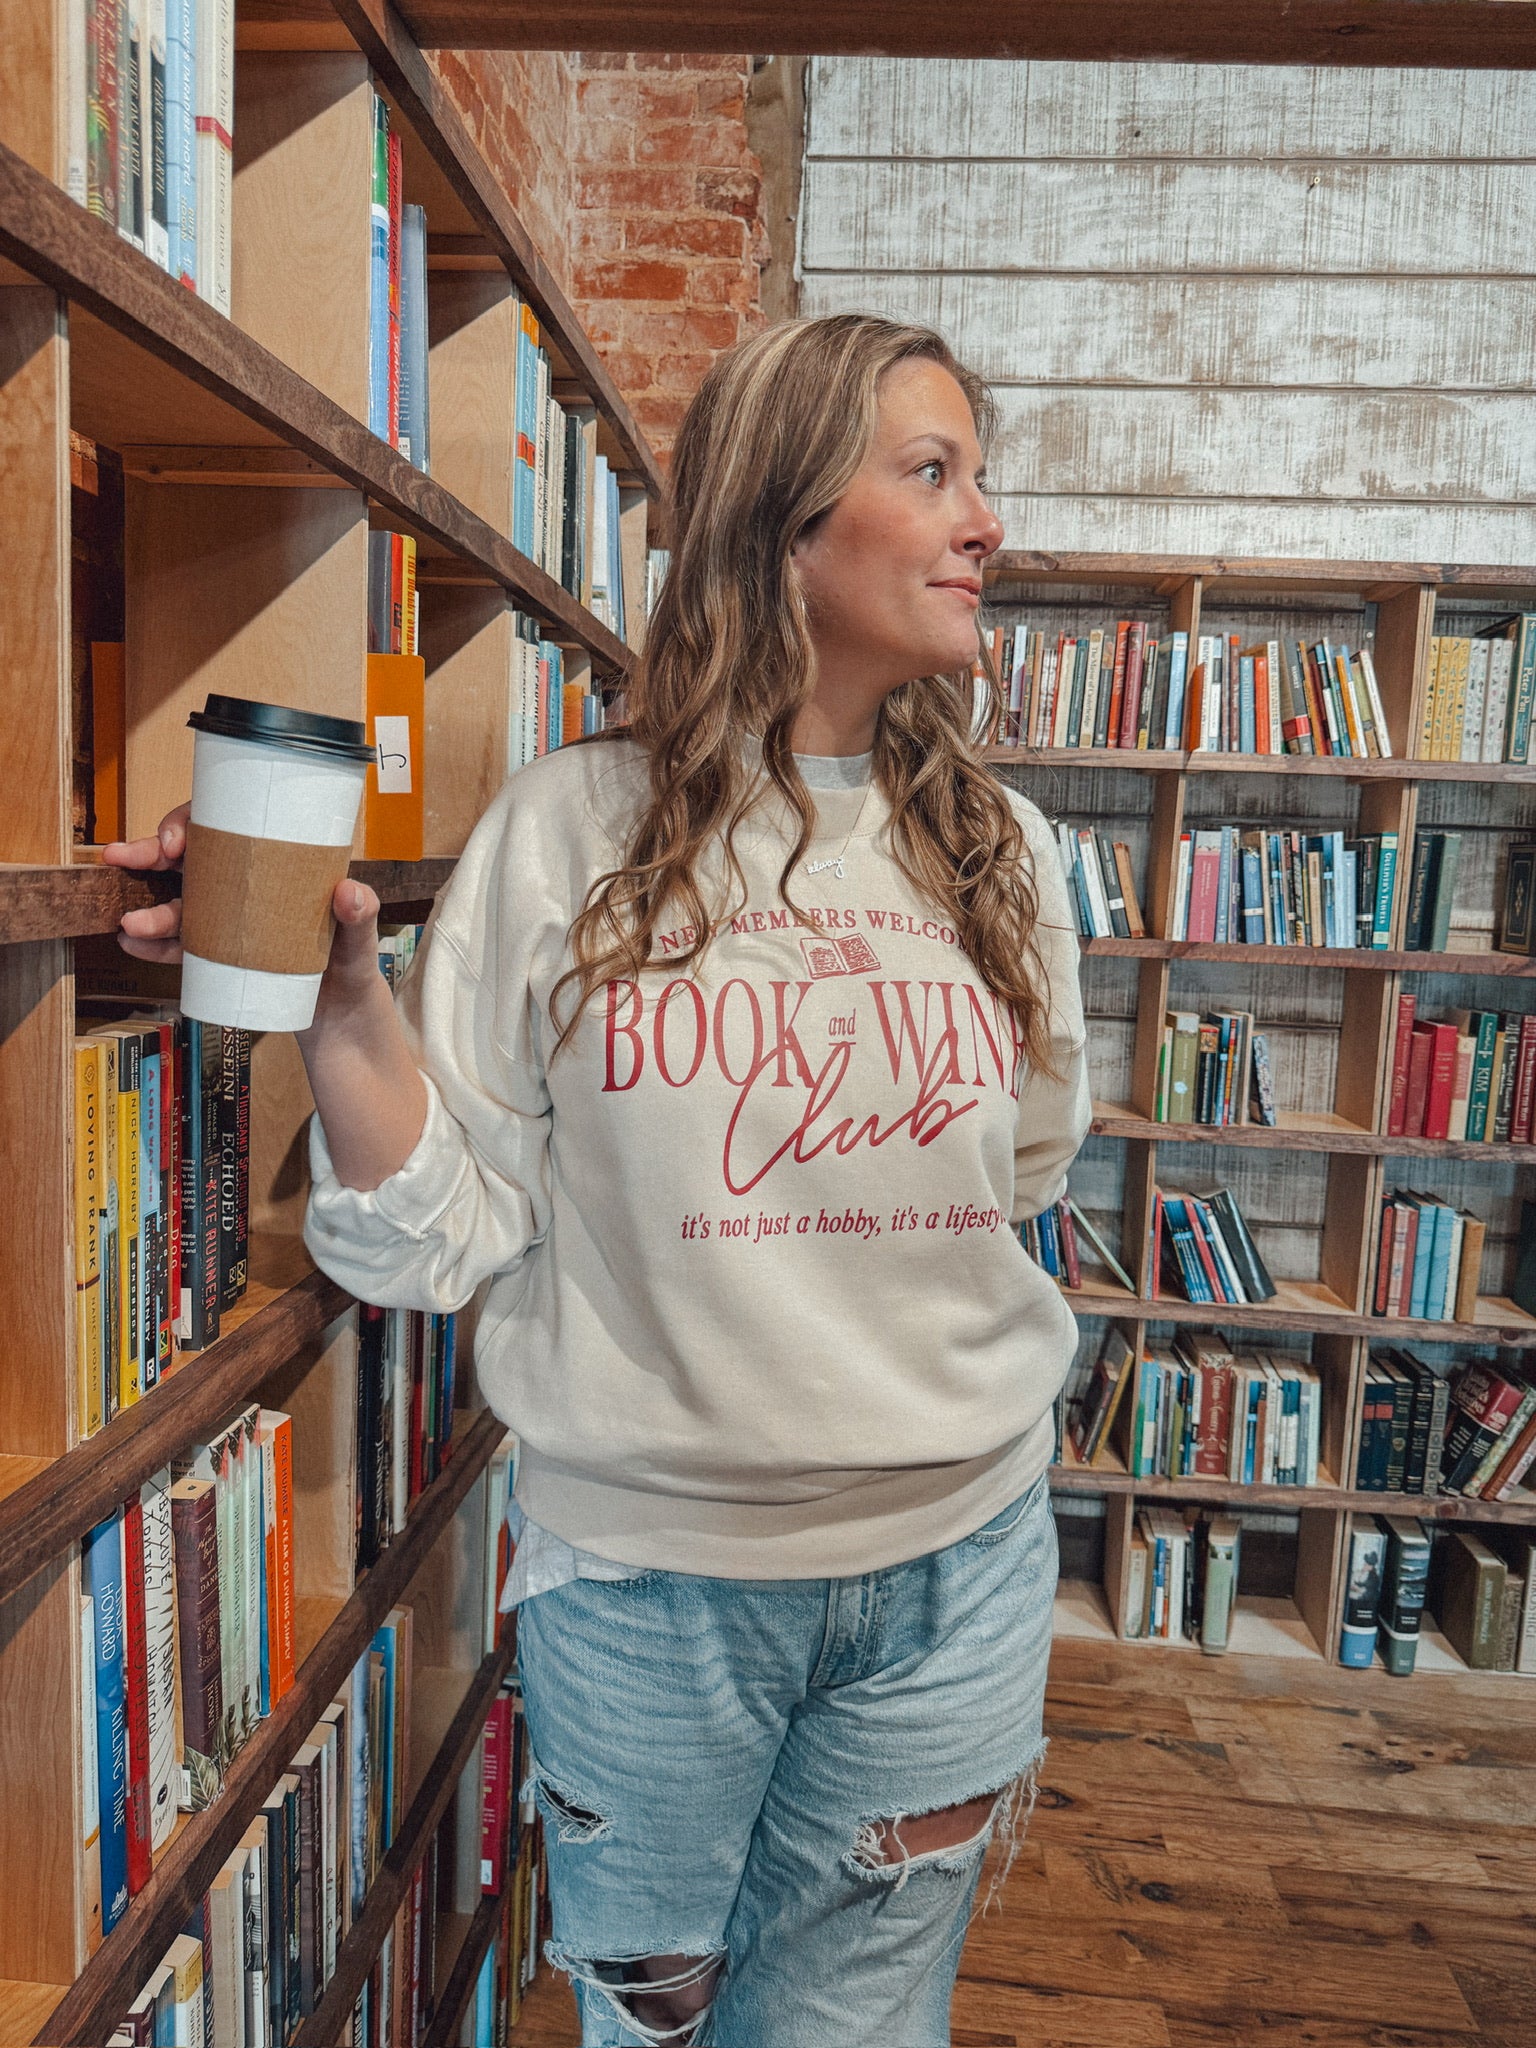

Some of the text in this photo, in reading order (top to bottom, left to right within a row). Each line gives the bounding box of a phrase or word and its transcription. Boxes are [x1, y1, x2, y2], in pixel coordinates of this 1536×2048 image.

[220, 36, 230, 80] book
[130, 57, 141, 177] HERE ON EARTH
[182, 65, 192, 133] PARADISE
[153, 76, 165, 196] HERE ON EARTH
[182, 139, 192, 186] HOTEL
[180, 196, 188, 242] HOGAN
[187, 208, 196, 242] RUTH
[1518, 667, 1533, 714] Peter Pan
[600, 978, 816, 1093] BOOK
[828, 1008, 856, 1037] and
[1475, 1067, 1490, 1092] KIM
[239, 1094, 249, 1152] THOUSAND
[722, 1026, 979, 1197] Club
[205, 1178, 217, 1226] KITE
[222, 1132, 234, 1232] ECHOED
[238, 1155, 248, 1212] SPLENDID
[237, 1211, 247, 1242] SUNS
[681, 1212, 711, 1239] it's
[719, 1203, 750, 1237] not
[753, 1211, 791, 1244] just
[796, 1214, 811, 1234] a
[815, 1207, 882, 1240] hobby,
[892, 1205, 919, 1232] it's
[925, 1211, 940, 1229] a
[205, 1227, 217, 1309] RUNNER
[158, 1484, 174, 1708] ABSOLUTE SUSAN
[283, 1560, 290, 1577] OF
[101, 1581, 115, 1660] HOWARD
[147, 1645, 157, 1735] HOWATCH
[207, 1685, 217, 1729] HOWE
[111, 1703, 126, 1834] KILLING TIME
